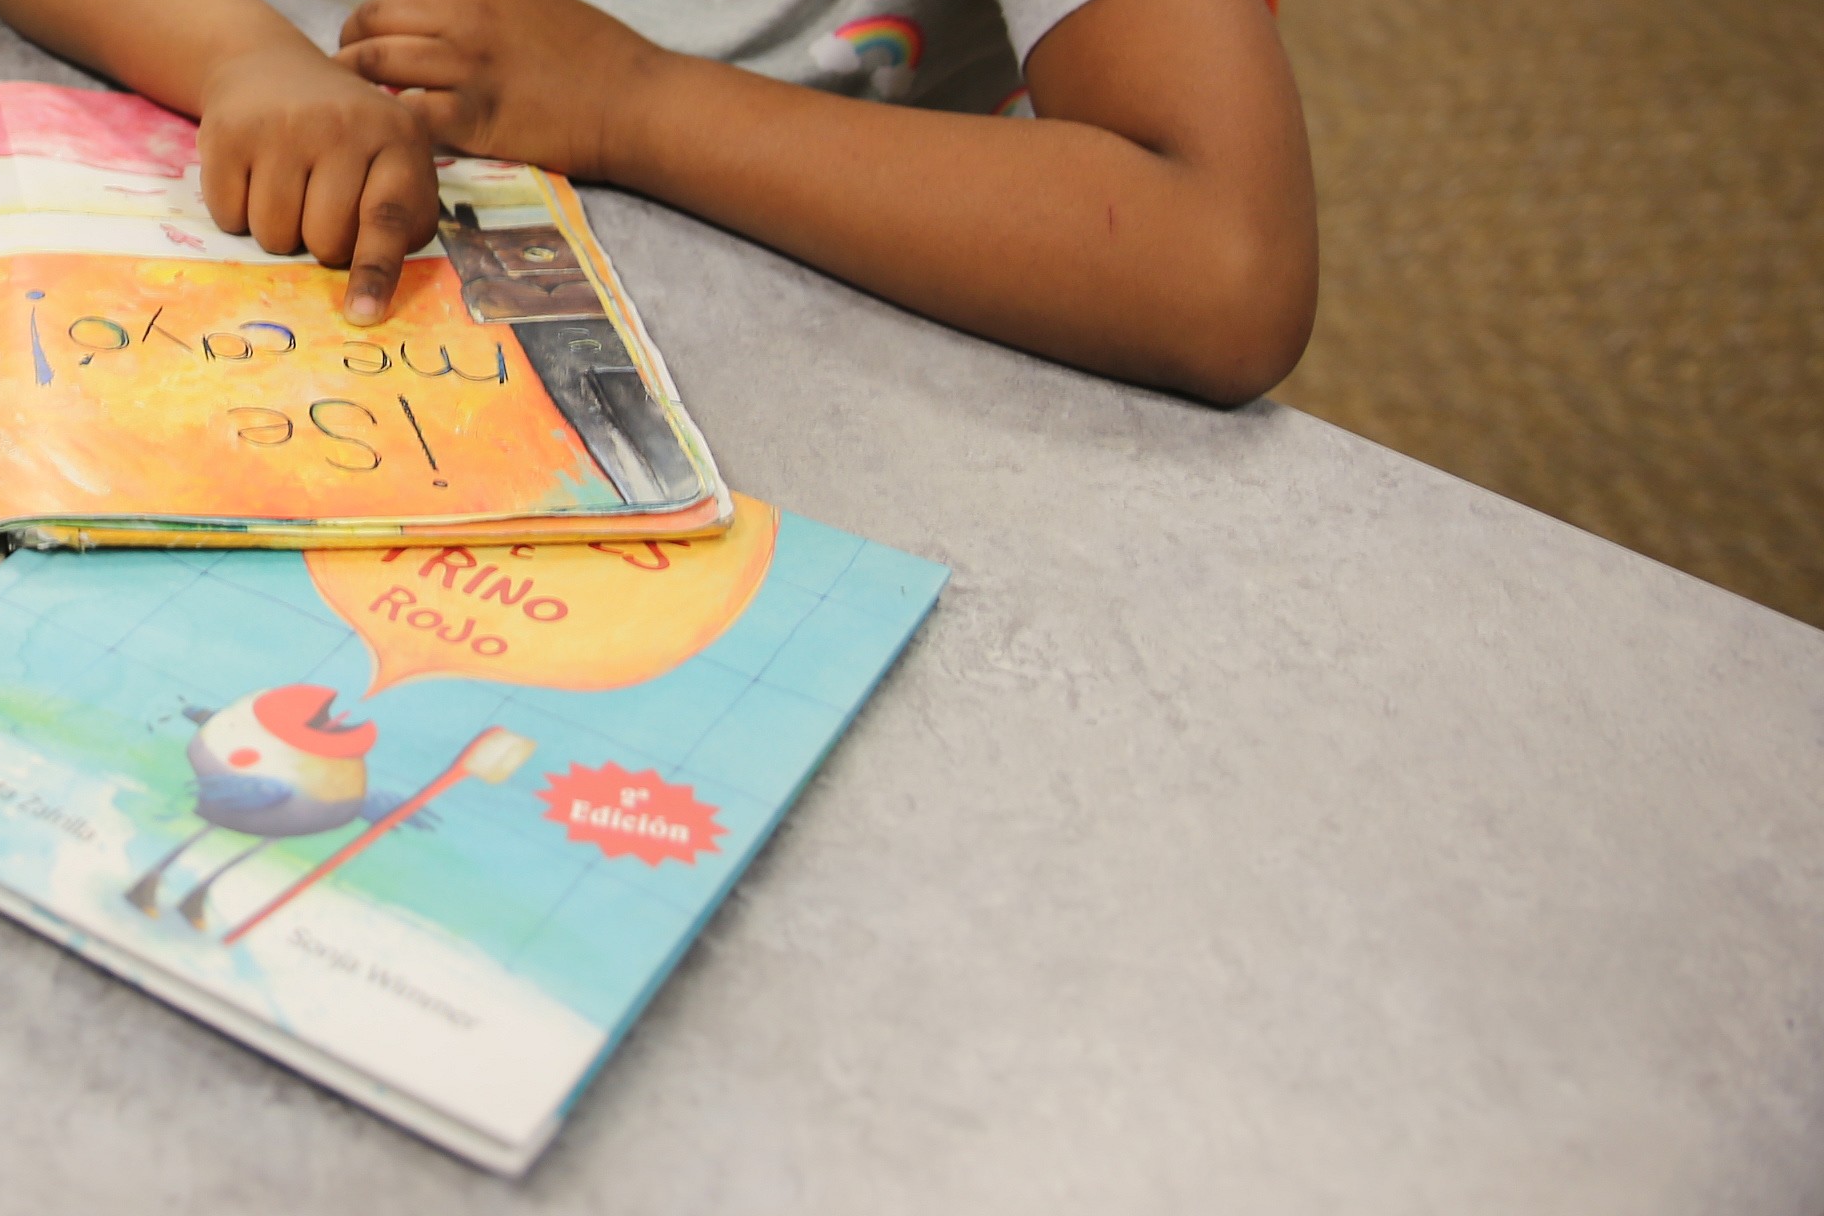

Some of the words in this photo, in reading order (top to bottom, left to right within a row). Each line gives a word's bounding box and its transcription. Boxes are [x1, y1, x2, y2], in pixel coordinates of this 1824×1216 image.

[342, 341, 509, 384] me
[369, 586, 508, 656] ROJO
[570, 798, 690, 845] Edición
